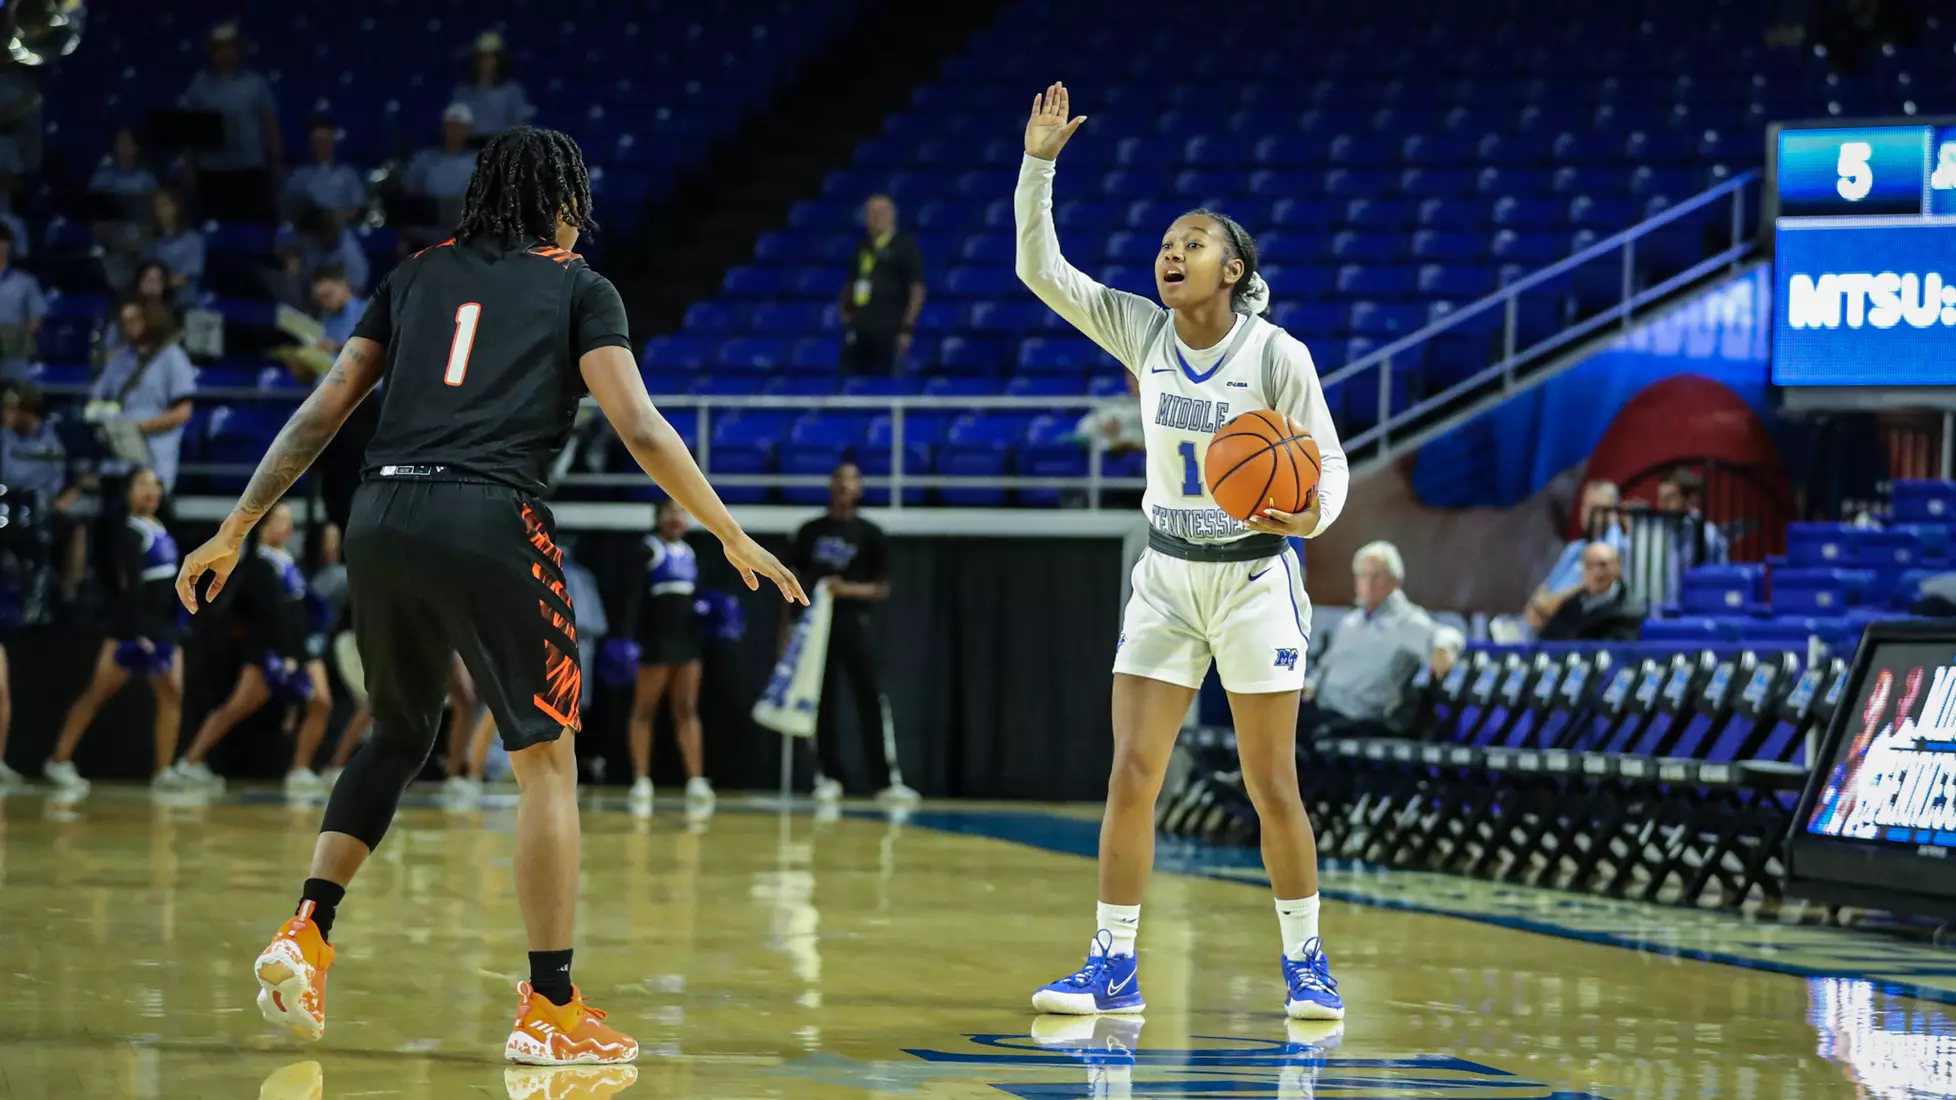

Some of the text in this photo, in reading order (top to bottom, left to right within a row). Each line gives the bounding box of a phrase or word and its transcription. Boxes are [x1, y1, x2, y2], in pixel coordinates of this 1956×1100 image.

[1836, 142, 1873, 201] 5
[443, 302, 482, 386] 1
[1154, 392, 1230, 434] MIDDLE
[1177, 440, 1204, 497] 1
[1151, 504, 1247, 539] TENNESSE
